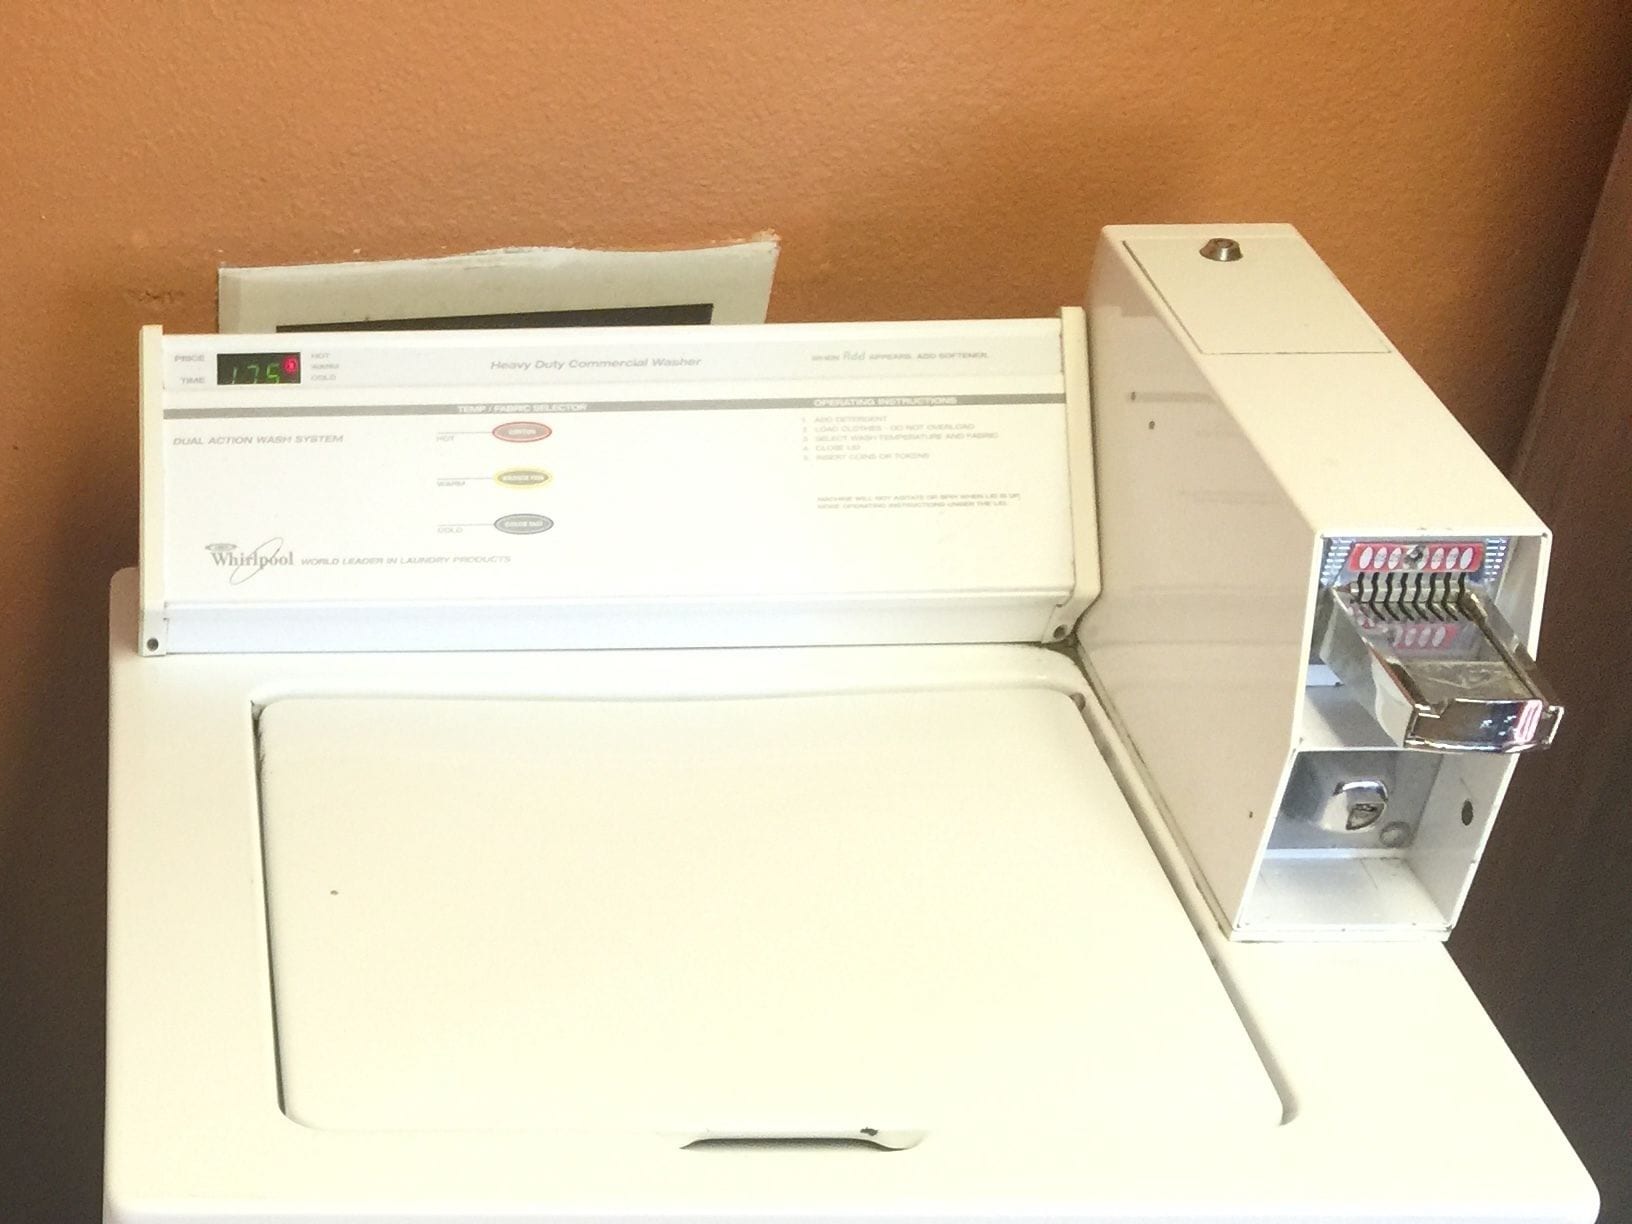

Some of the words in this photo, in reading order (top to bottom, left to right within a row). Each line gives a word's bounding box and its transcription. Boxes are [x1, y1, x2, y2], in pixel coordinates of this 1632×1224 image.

[490, 360, 531, 370] Heavy
[535, 360, 565, 370] Duty
[569, 359, 648, 369] Commercial
[652, 357, 702, 367] Washer
[173, 437, 204, 446] DUAL
[208, 436, 253, 445] ACTION
[256, 435, 292, 444] WASH
[295, 434, 345, 444] SYSTEM
[210, 552, 294, 569] Whirlpool
[300, 557, 340, 566] WORLD
